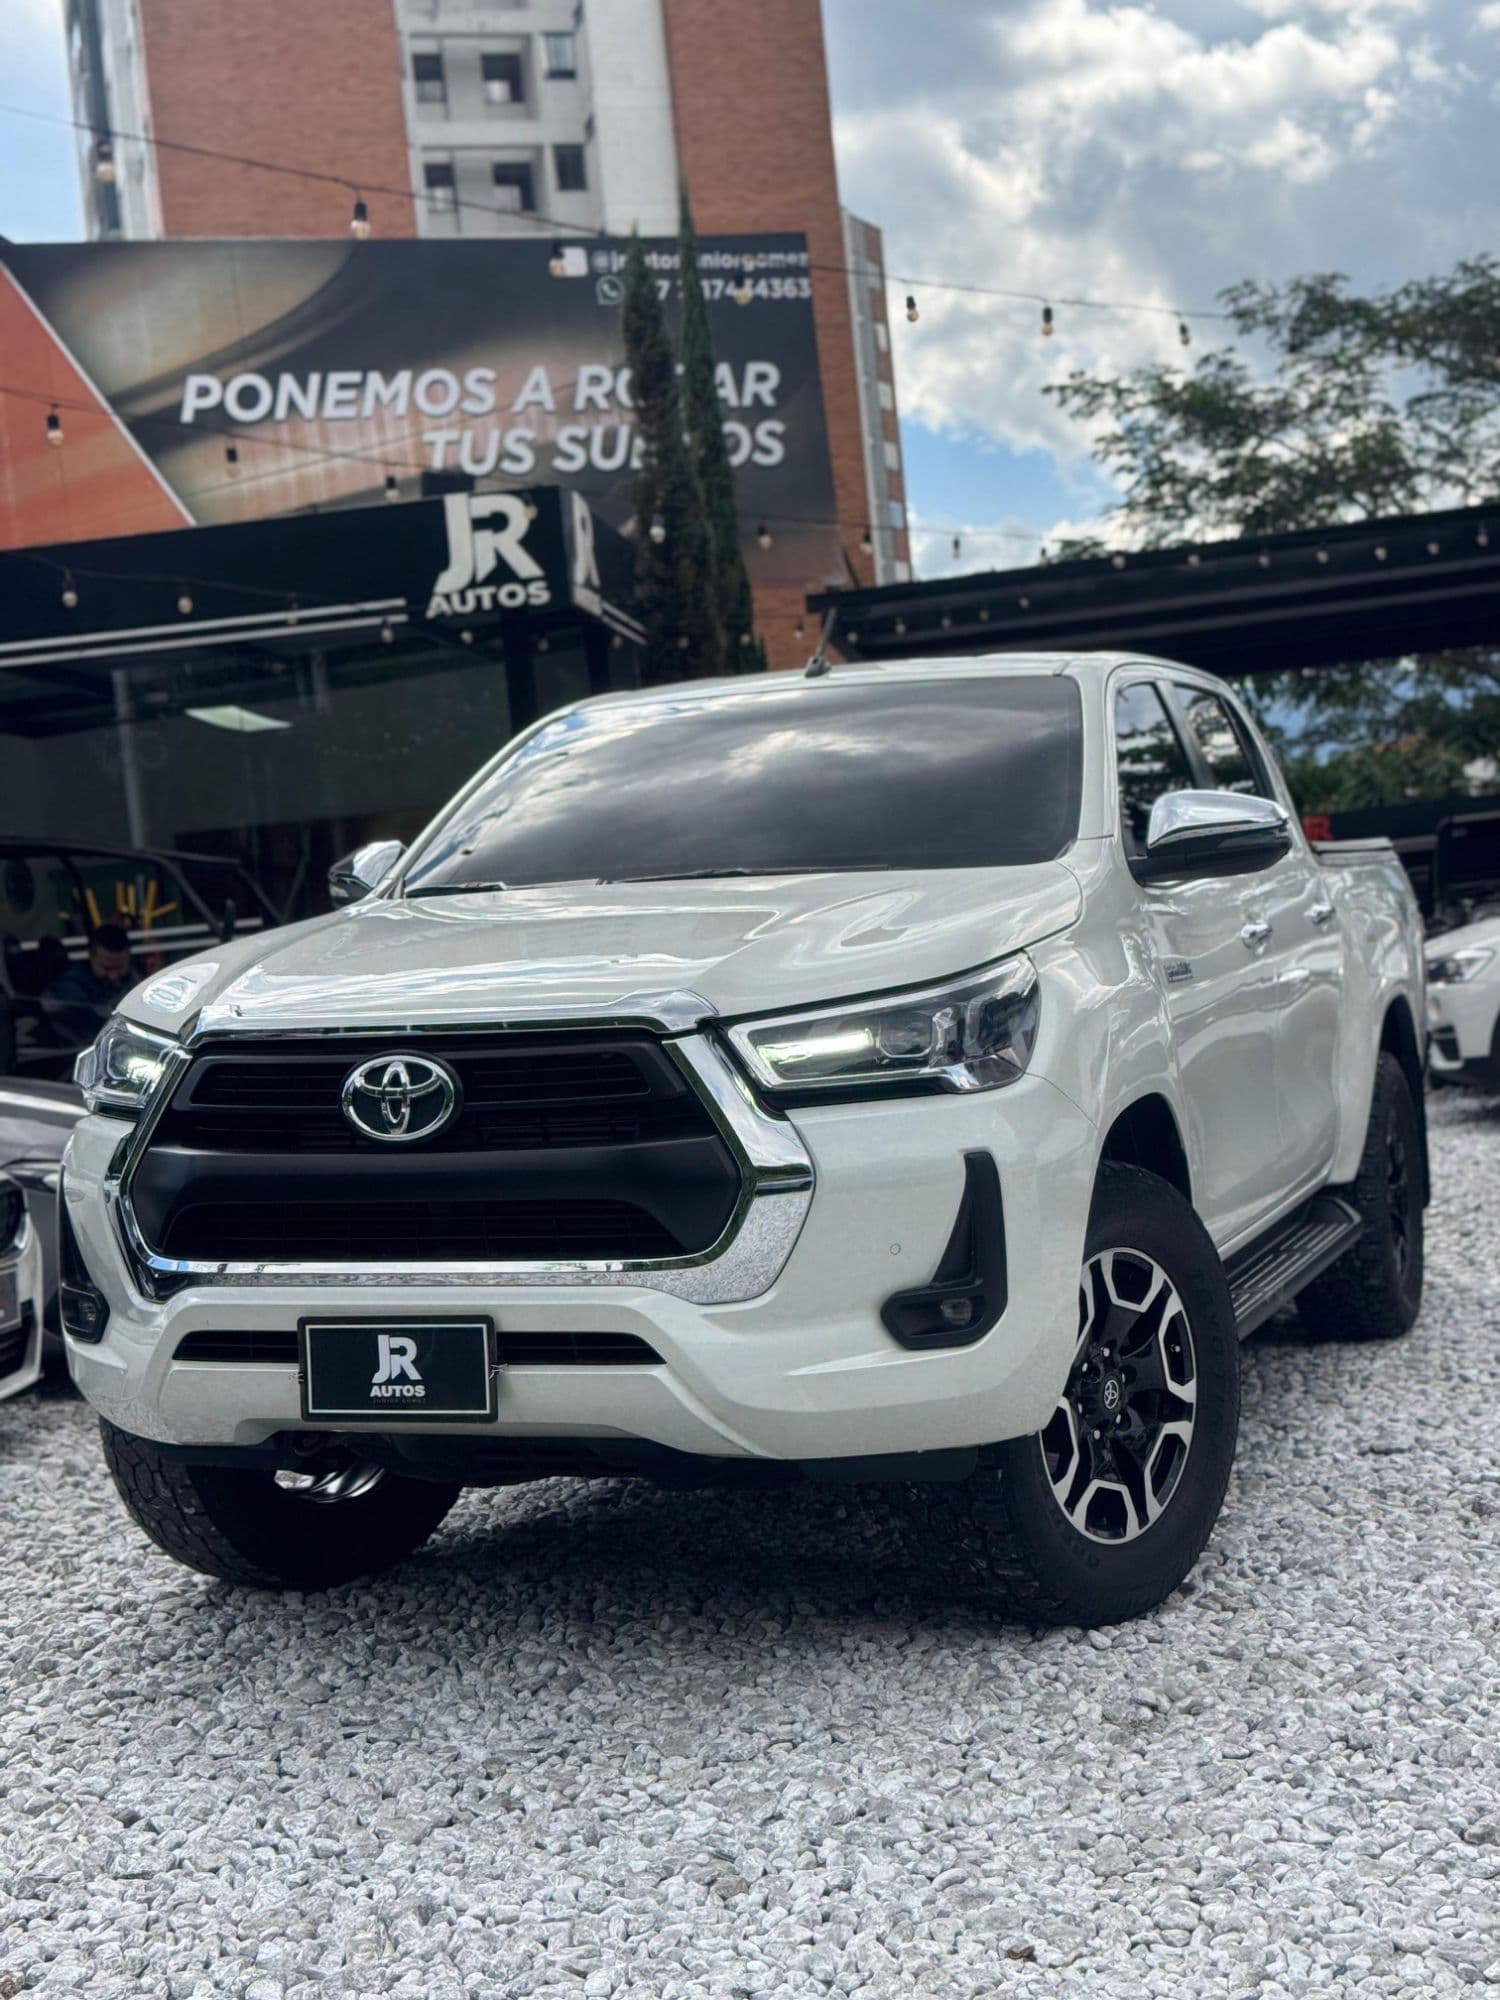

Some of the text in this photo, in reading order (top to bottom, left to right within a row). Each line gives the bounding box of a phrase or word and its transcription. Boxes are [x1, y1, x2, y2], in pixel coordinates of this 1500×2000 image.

[180, 364, 499, 425] PONEMOS
[511, 366, 561, 413] A
[421, 427, 537, 476] TUS
[432, 492, 545, 595] JR
[424, 580, 552, 620] AUTOS
[371, 1334, 423, 1384] JR
[370, 1385, 426, 1397] AUTOS
